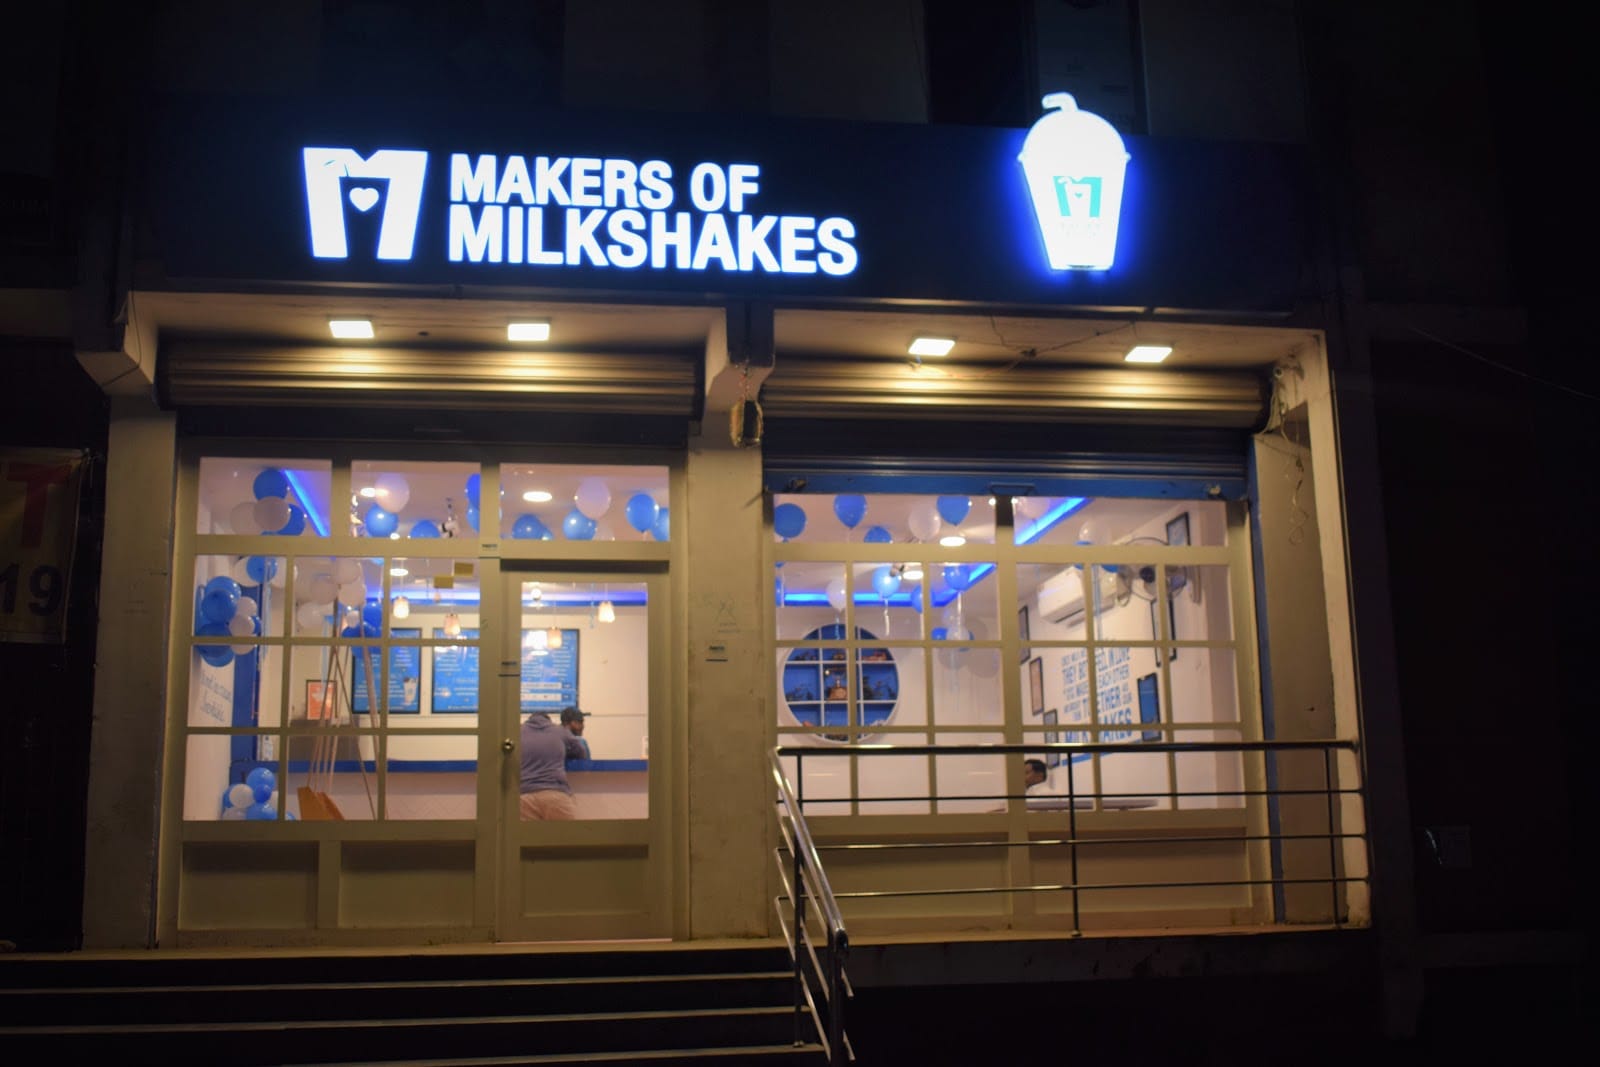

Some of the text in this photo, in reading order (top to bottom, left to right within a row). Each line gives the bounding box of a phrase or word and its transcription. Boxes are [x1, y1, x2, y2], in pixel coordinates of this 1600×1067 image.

[449, 153, 760, 212] MAKERS OF
[448, 204, 858, 277] MILKSHAKES
